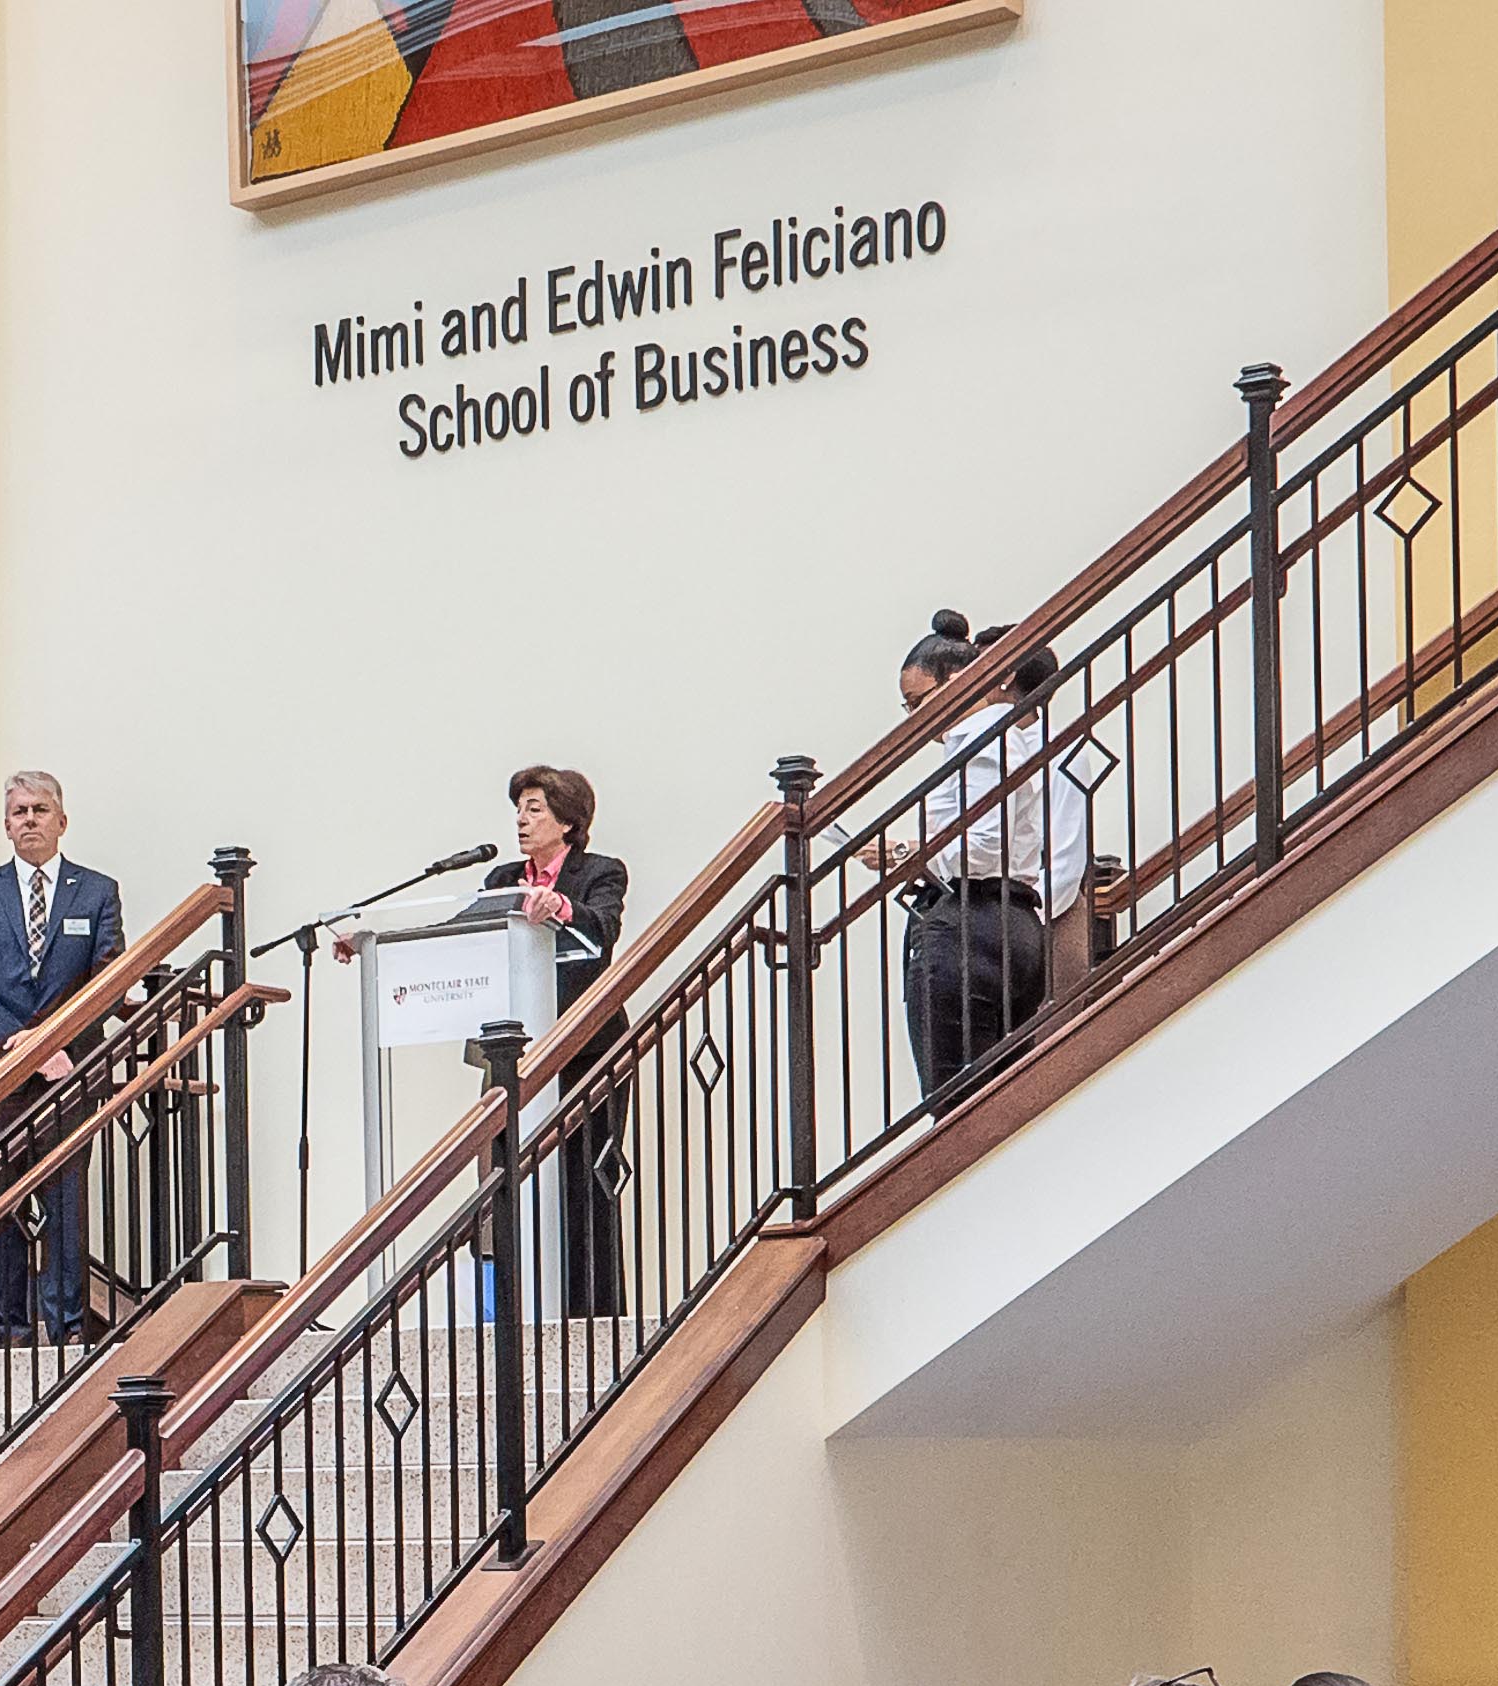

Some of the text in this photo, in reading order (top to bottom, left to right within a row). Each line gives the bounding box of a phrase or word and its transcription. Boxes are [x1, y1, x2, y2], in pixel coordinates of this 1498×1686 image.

[314, 201, 946, 388] Mimi and Edwin Feliciano
[398, 317, 869, 458] School of Business
[465, 976, 489, 987] STATE
